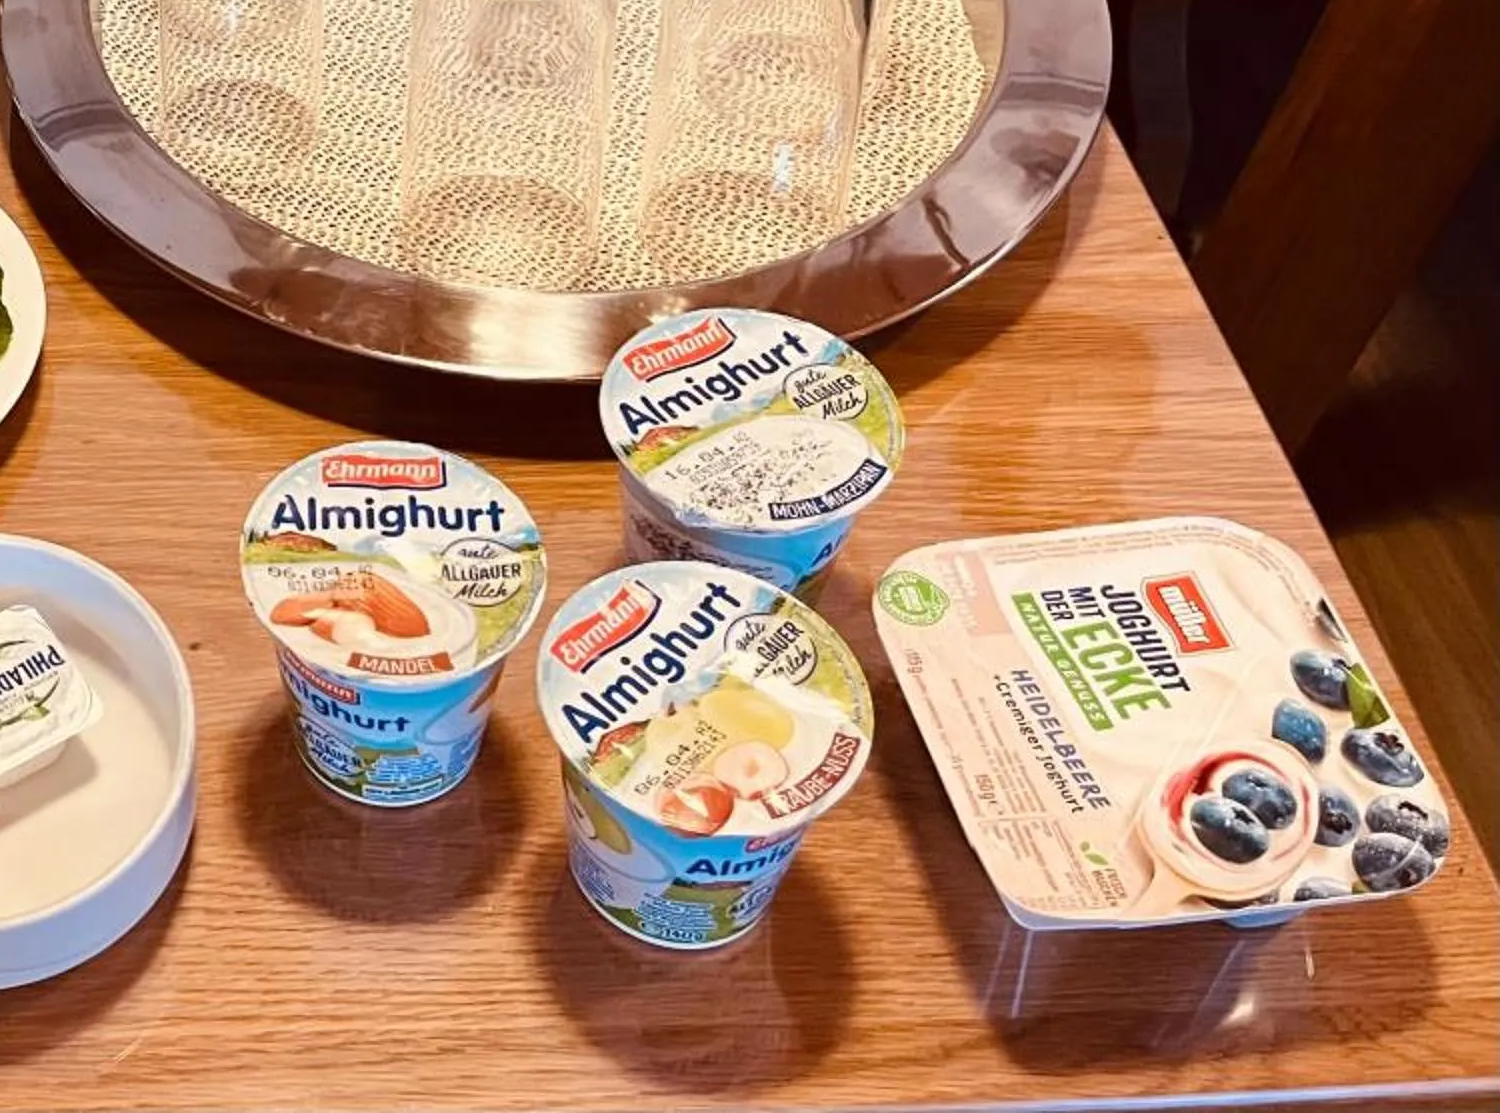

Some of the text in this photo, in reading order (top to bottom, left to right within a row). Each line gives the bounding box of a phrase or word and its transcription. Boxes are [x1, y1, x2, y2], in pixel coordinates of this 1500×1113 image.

[631, 323, 724, 378] Ehrmann
[619, 330, 809, 435] Almighurt
[822, 392, 863, 420] Milch
[325, 458, 438, 480] Ehrmann
[271, 494, 505, 538] Almighurt
[453, 583, 508, 600] Milch
[1041, 590, 1075, 622] DER
[1158, 585, 1211, 643] müller
[560, 591, 646, 666] Ehrmann
[1061, 586, 1172, 719] MIT ECKE
[1100, 584, 1191, 692] JOGHURT
[358, 656, 439, 675] MANDEL
[562, 582, 742, 744] Almighurt
[1016, 599, 1103, 721] NATUR GENUSS
[1010, 669, 1112, 810] HEIDELBEERE
[1036, 752, 1085, 814] Joghurt
